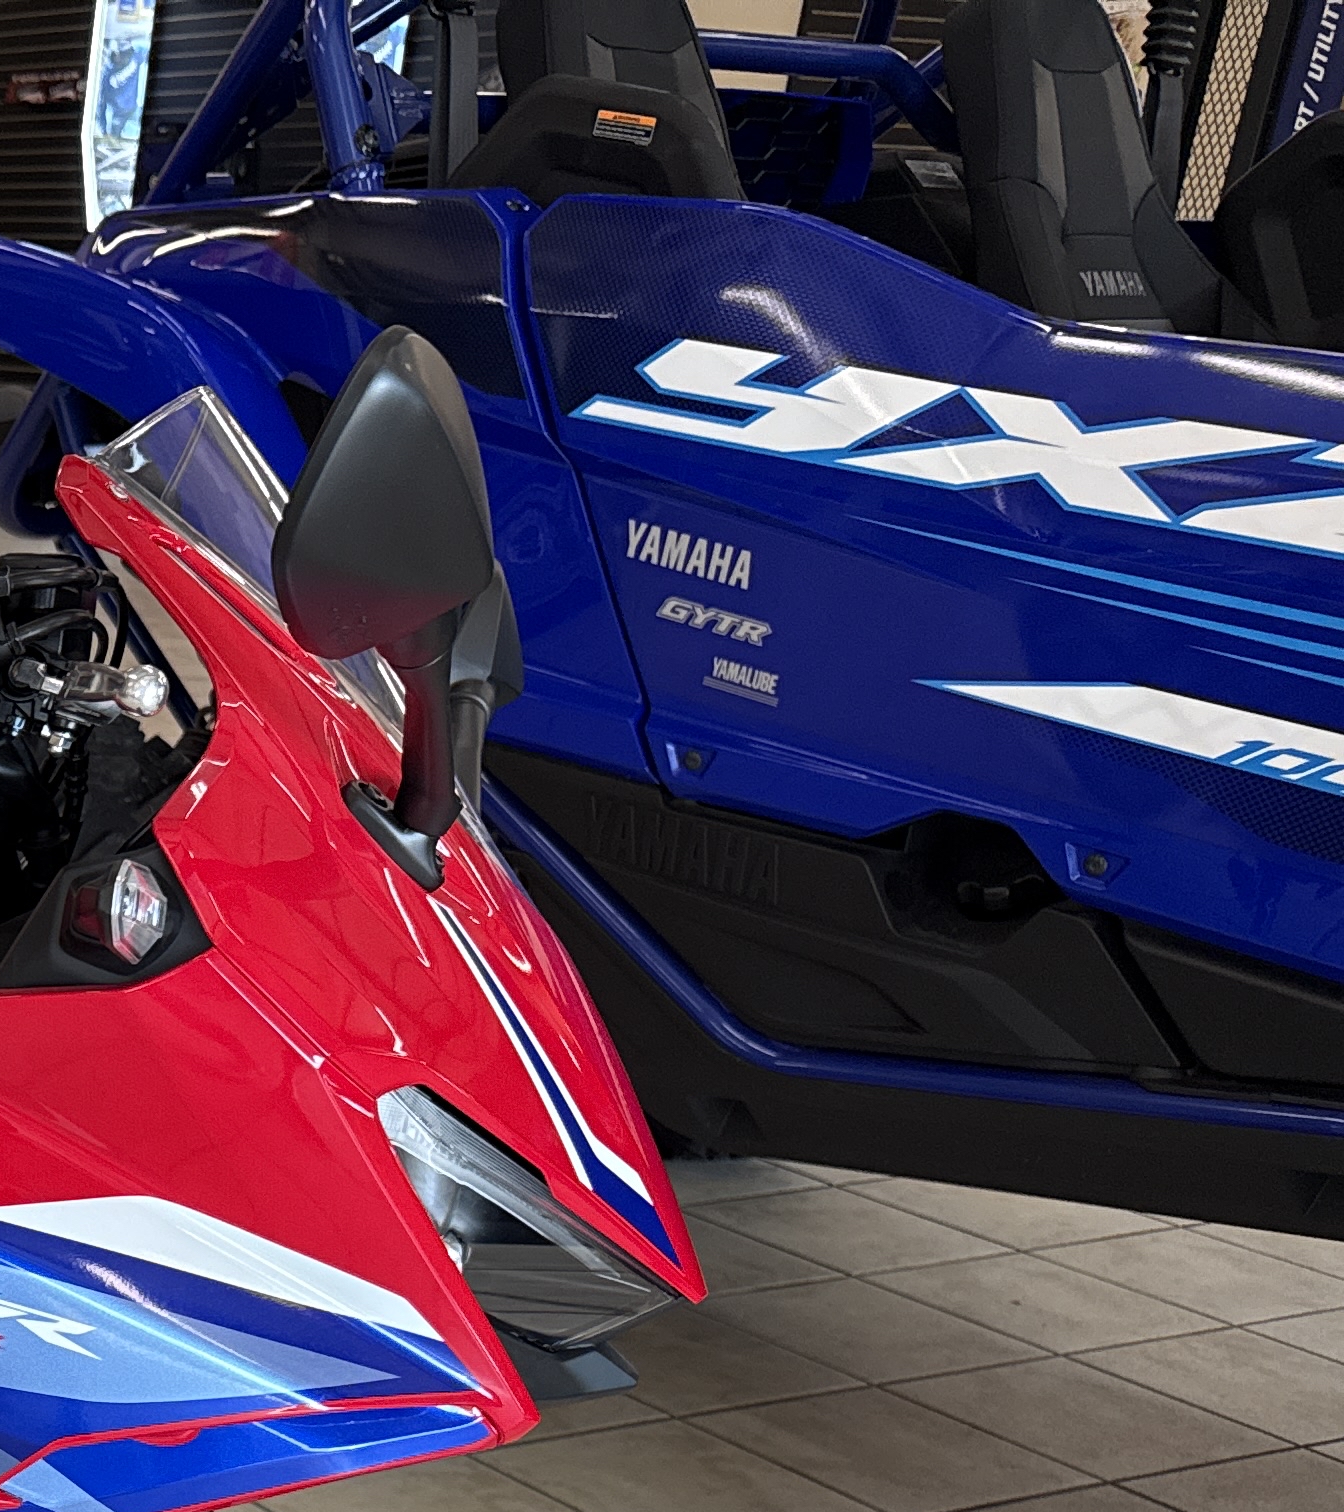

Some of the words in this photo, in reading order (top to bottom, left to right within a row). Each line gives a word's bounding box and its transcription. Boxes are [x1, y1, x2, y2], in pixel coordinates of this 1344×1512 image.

[1307, 0, 1343, 82] UTILIT
[1079, 270, 1147, 297] YAMAHA
[626, 518, 752, 590] YAMAHA
[656, 596, 773, 647] GYTR
[712, 656, 779, 695] YAMALUBE
